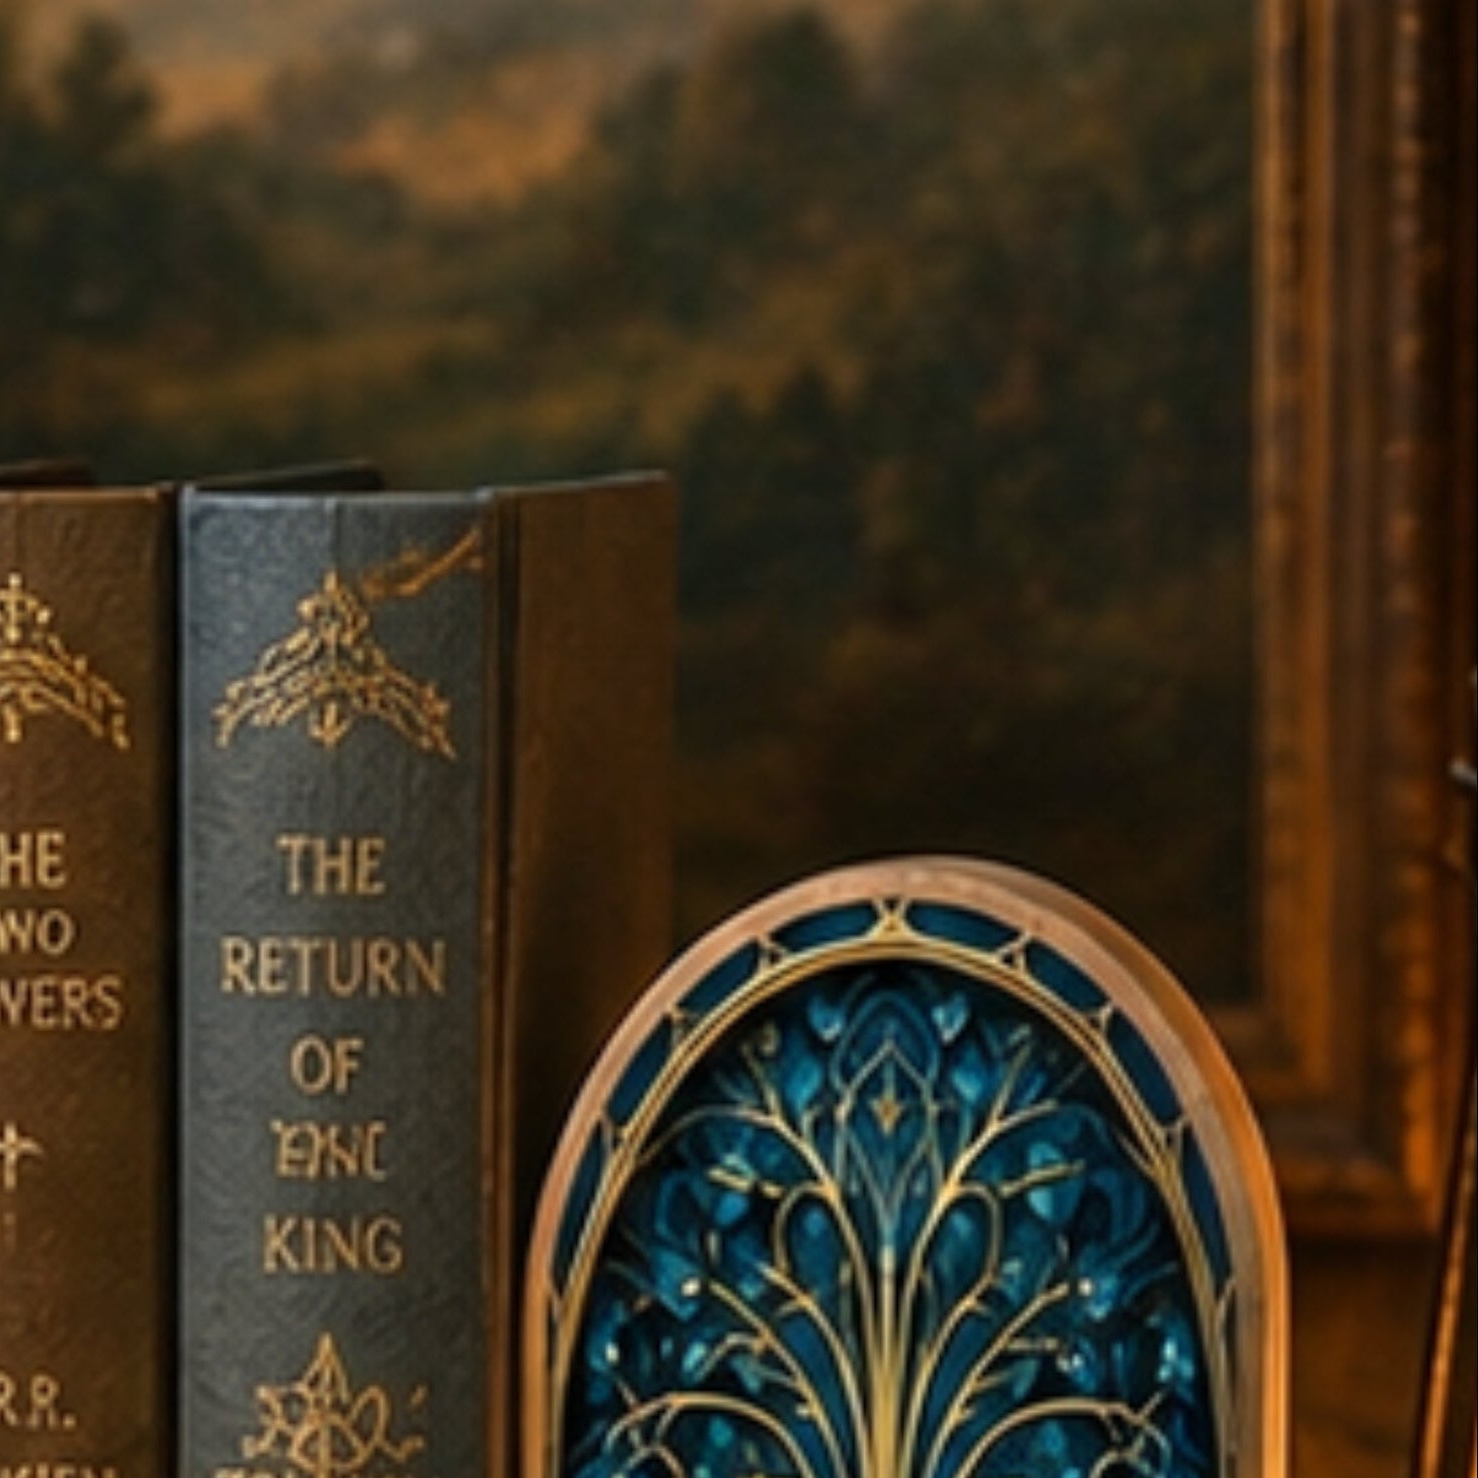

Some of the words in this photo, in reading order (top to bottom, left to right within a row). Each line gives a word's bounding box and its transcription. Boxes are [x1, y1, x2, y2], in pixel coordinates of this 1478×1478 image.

[277, 835, 385, 894] THE
[222, 937, 444, 995] RETURN
[291, 1035, 363, 1094] OF
[264, 1216, 403, 1273] KING
